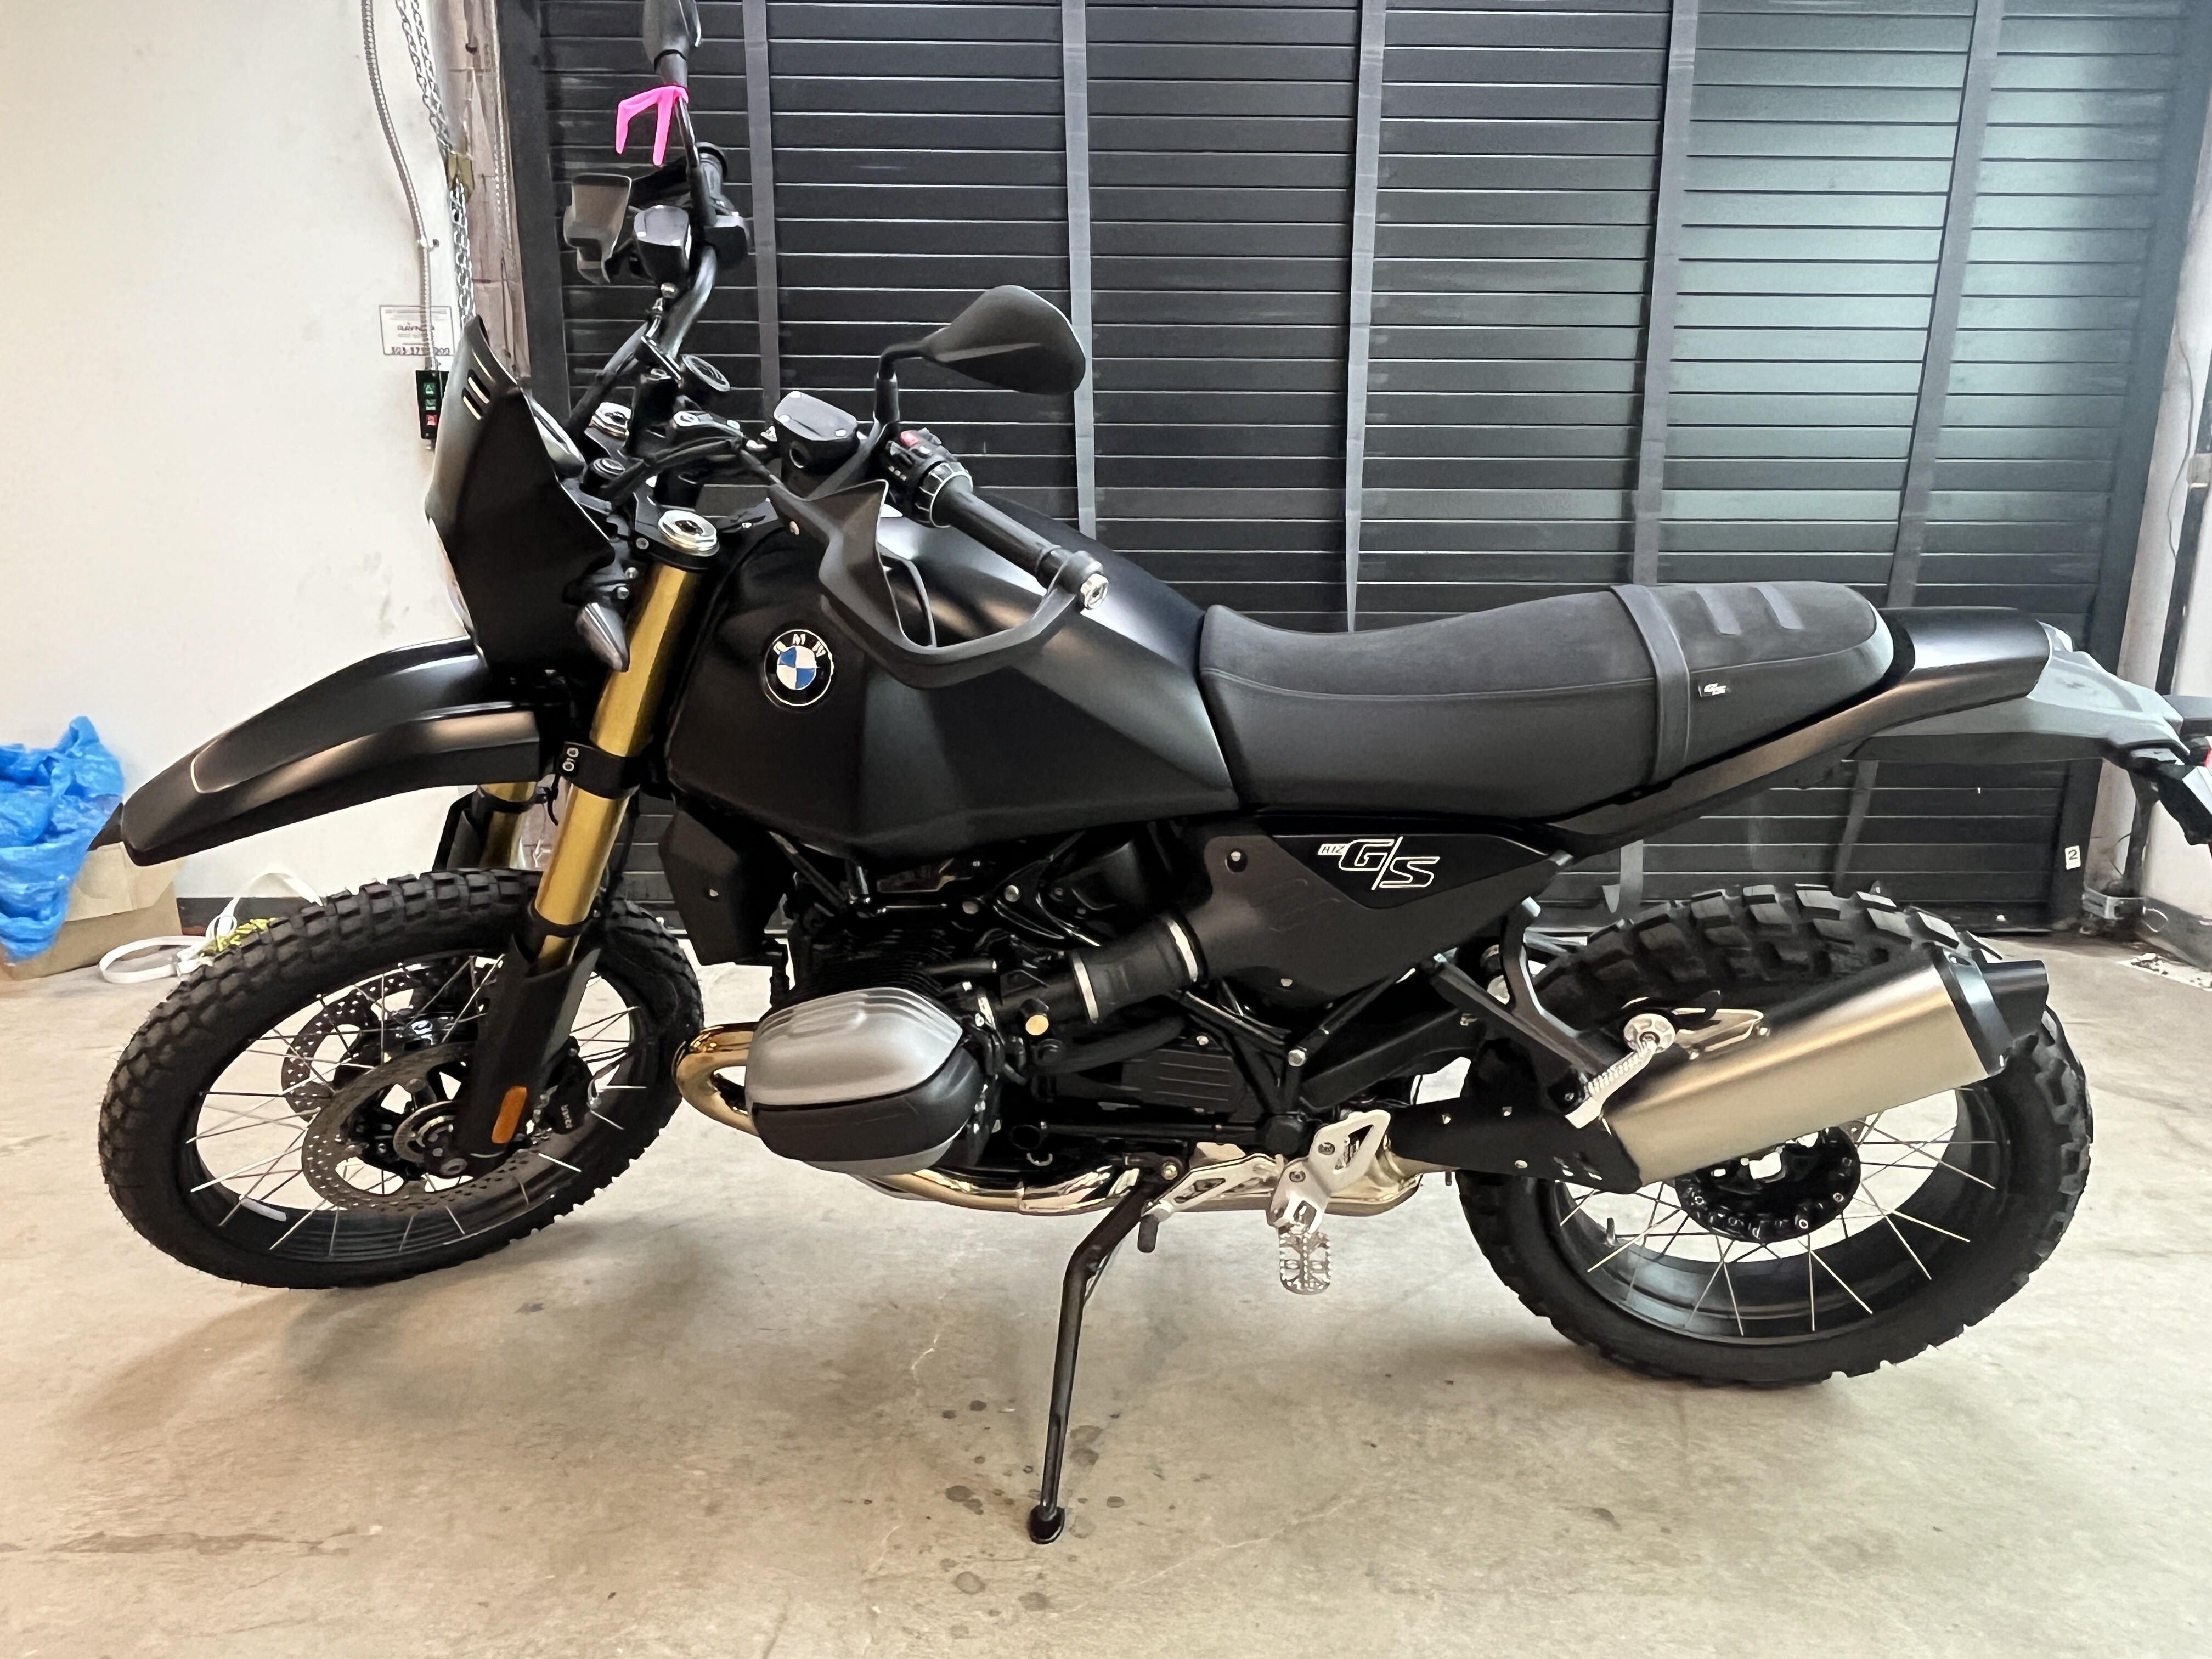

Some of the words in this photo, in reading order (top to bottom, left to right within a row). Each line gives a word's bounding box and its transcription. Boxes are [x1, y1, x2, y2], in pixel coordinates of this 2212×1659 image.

[772, 633, 826, 657] BMW
[1339, 836, 1440, 891] G/S
[2068, 849, 2078, 860] 2
